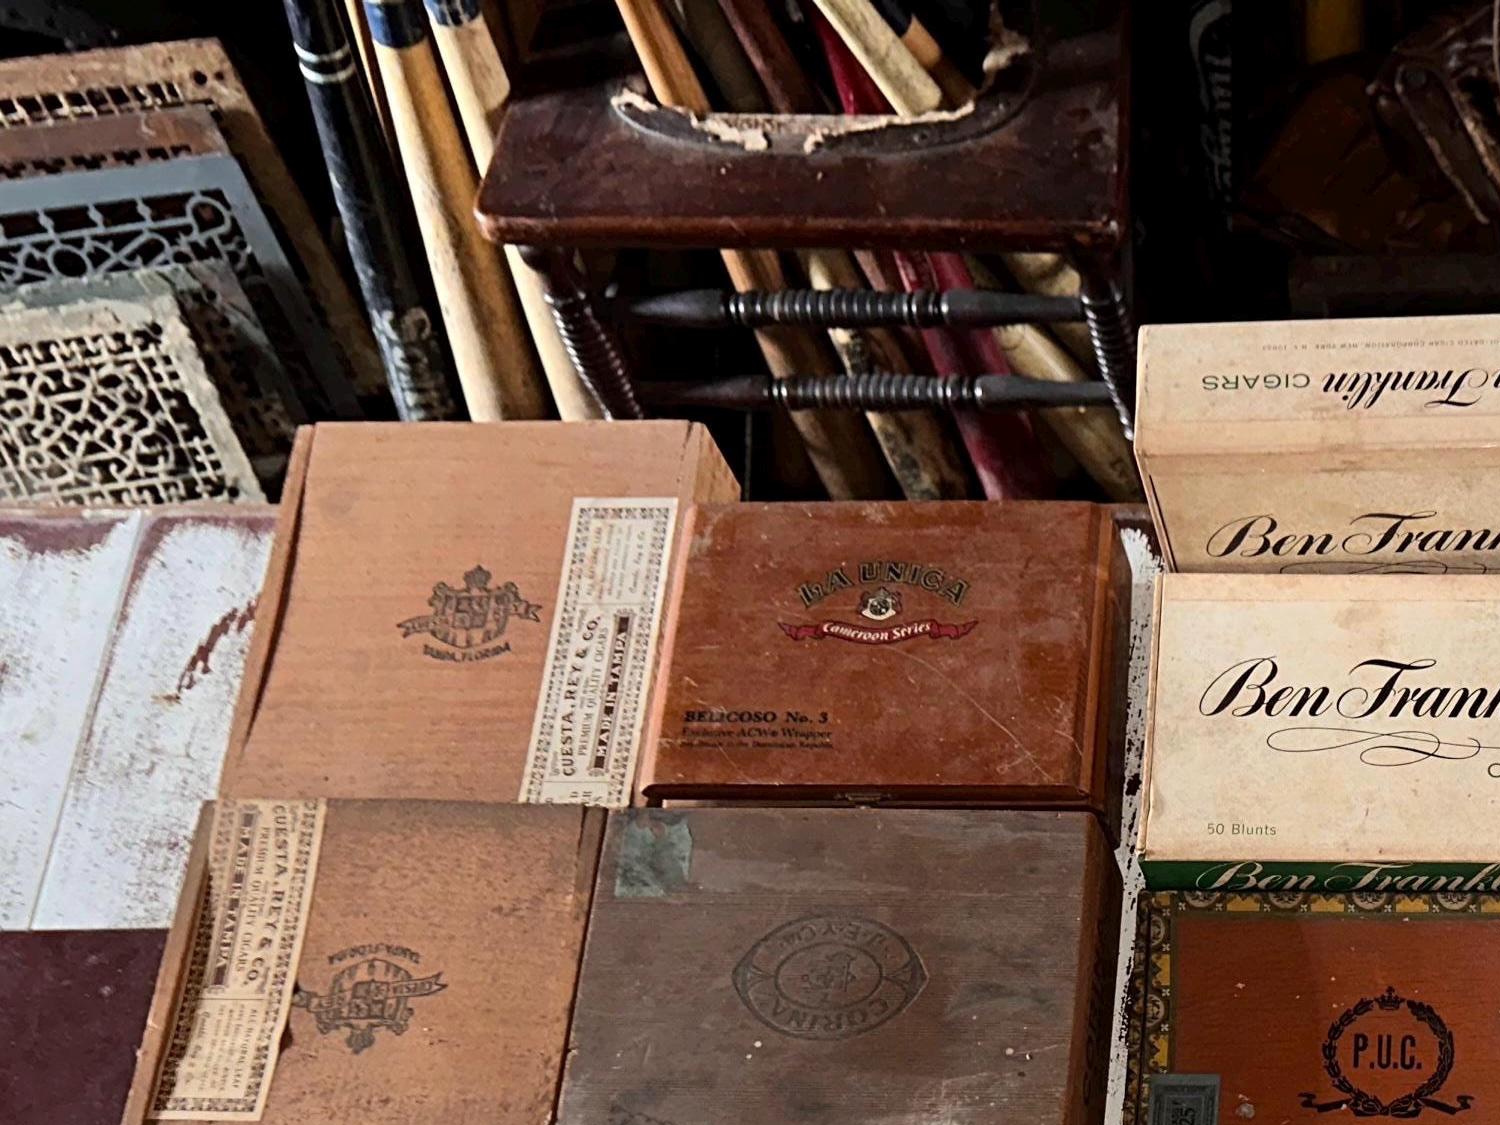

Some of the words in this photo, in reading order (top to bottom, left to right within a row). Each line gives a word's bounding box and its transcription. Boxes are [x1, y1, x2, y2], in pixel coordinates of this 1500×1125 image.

[1203, 372, 1311, 391] CIGARS
[1322, 366, 1492, 410] Franklin
[1207, 514, 1340, 558] Ben
[796, 566, 855, 610] LA
[859, 560, 971, 608] UNICA
[822, 621, 890, 642] Cameroon
[892, 619, 932, 641] Series
[564, 666, 584, 701] REY
[1199, 655, 1335, 718] Ben
[684, 710, 778, 724] BELICOSO
[818, 710, 830, 724] 3
[1207, 822, 1226, 836] 50
[1231, 821, 1278, 837] Blunts
[1196, 861, 1319, 893] Ben
[268, 884, 287, 933] REY
[1352, 1033, 1423, 1070] P.U.C.
